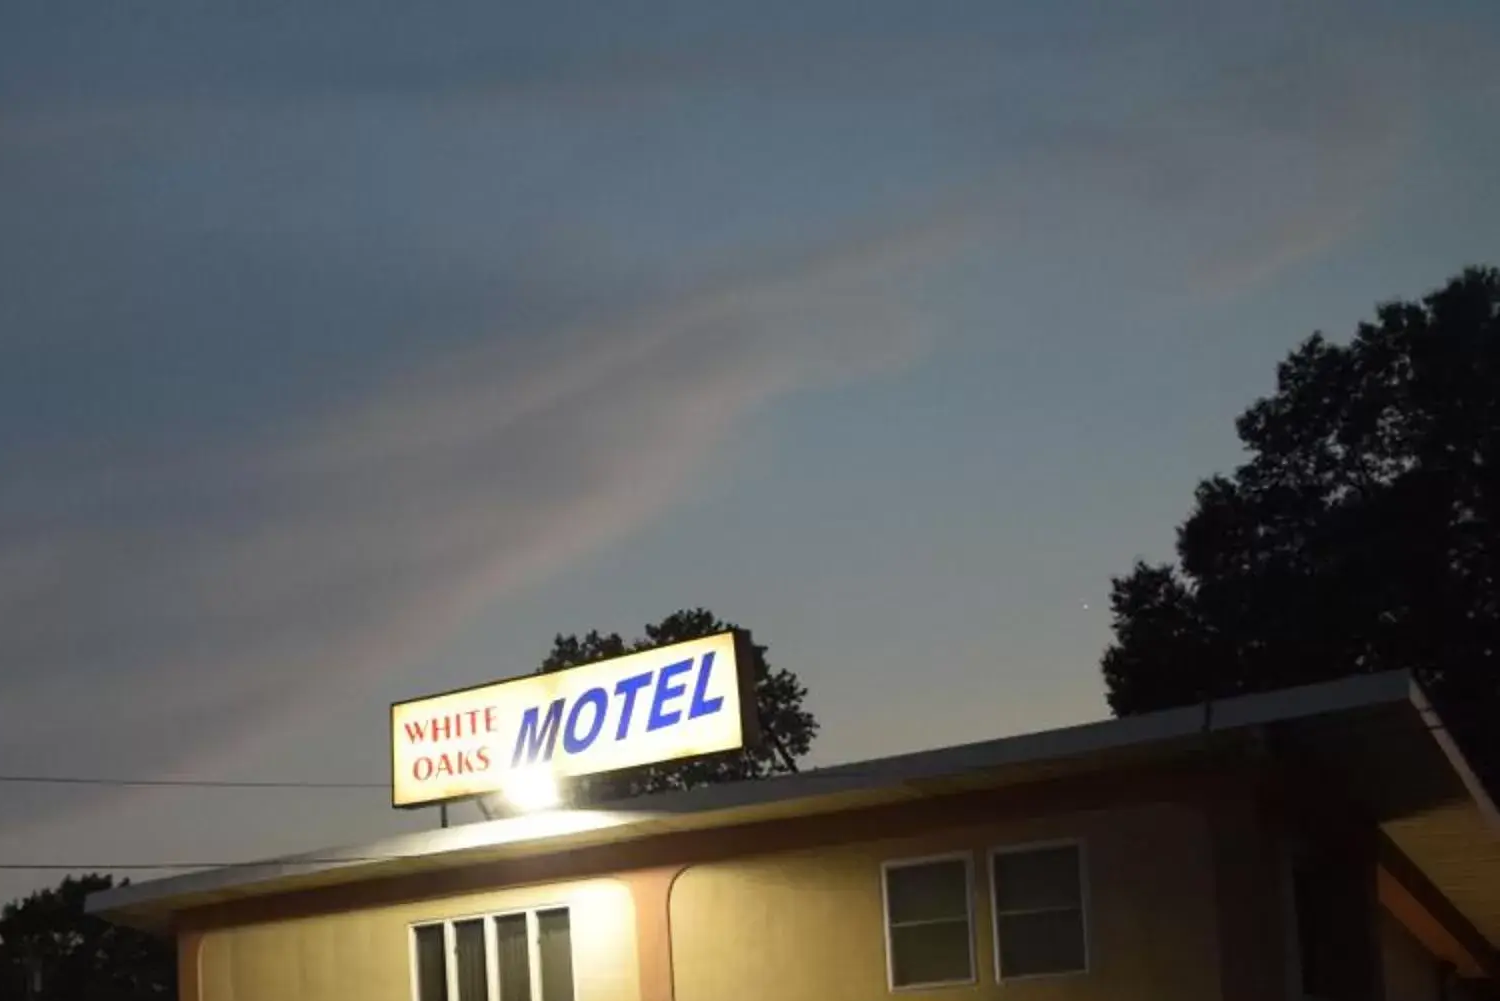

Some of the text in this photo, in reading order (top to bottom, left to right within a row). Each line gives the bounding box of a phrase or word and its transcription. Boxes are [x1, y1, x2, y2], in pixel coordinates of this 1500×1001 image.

[404, 706, 498, 744] WHITE
[511, 651, 724, 769] MOTEL
[412, 746, 490, 782] OAKS
